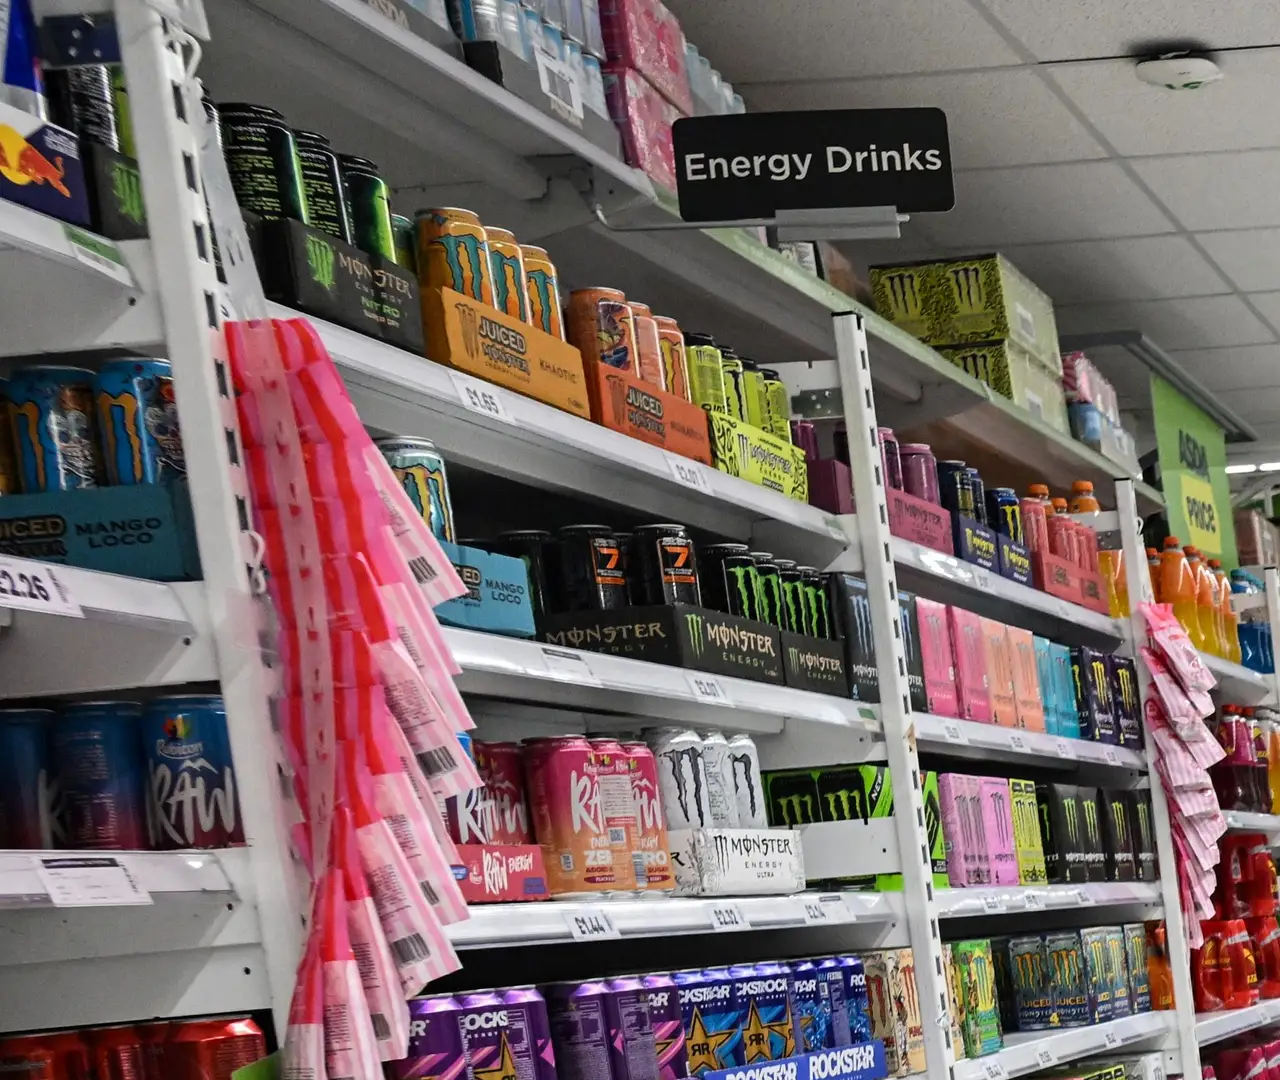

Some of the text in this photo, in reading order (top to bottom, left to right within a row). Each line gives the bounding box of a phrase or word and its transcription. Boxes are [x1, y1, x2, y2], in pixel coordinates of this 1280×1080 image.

[686, 143, 942, 186] Energy Drinks
[466, 386, 499, 415] £1.65
[1179, 429, 1209, 484] ASDA
[75, 517, 162, 536] MANGO
[88, 532, 153, 549] LOCO
[595, 547, 619, 568] 7
[664, 547, 689, 568] 7
[485, 580, 525, 596] MANGO
[491, 590, 522, 605] LOCO
[706, 624, 776, 658] MONSTER
[799, 653, 843, 676] MONSTER
[732, 834, 793, 857] MONSTER
[744, 860, 784, 870] ENERGY
